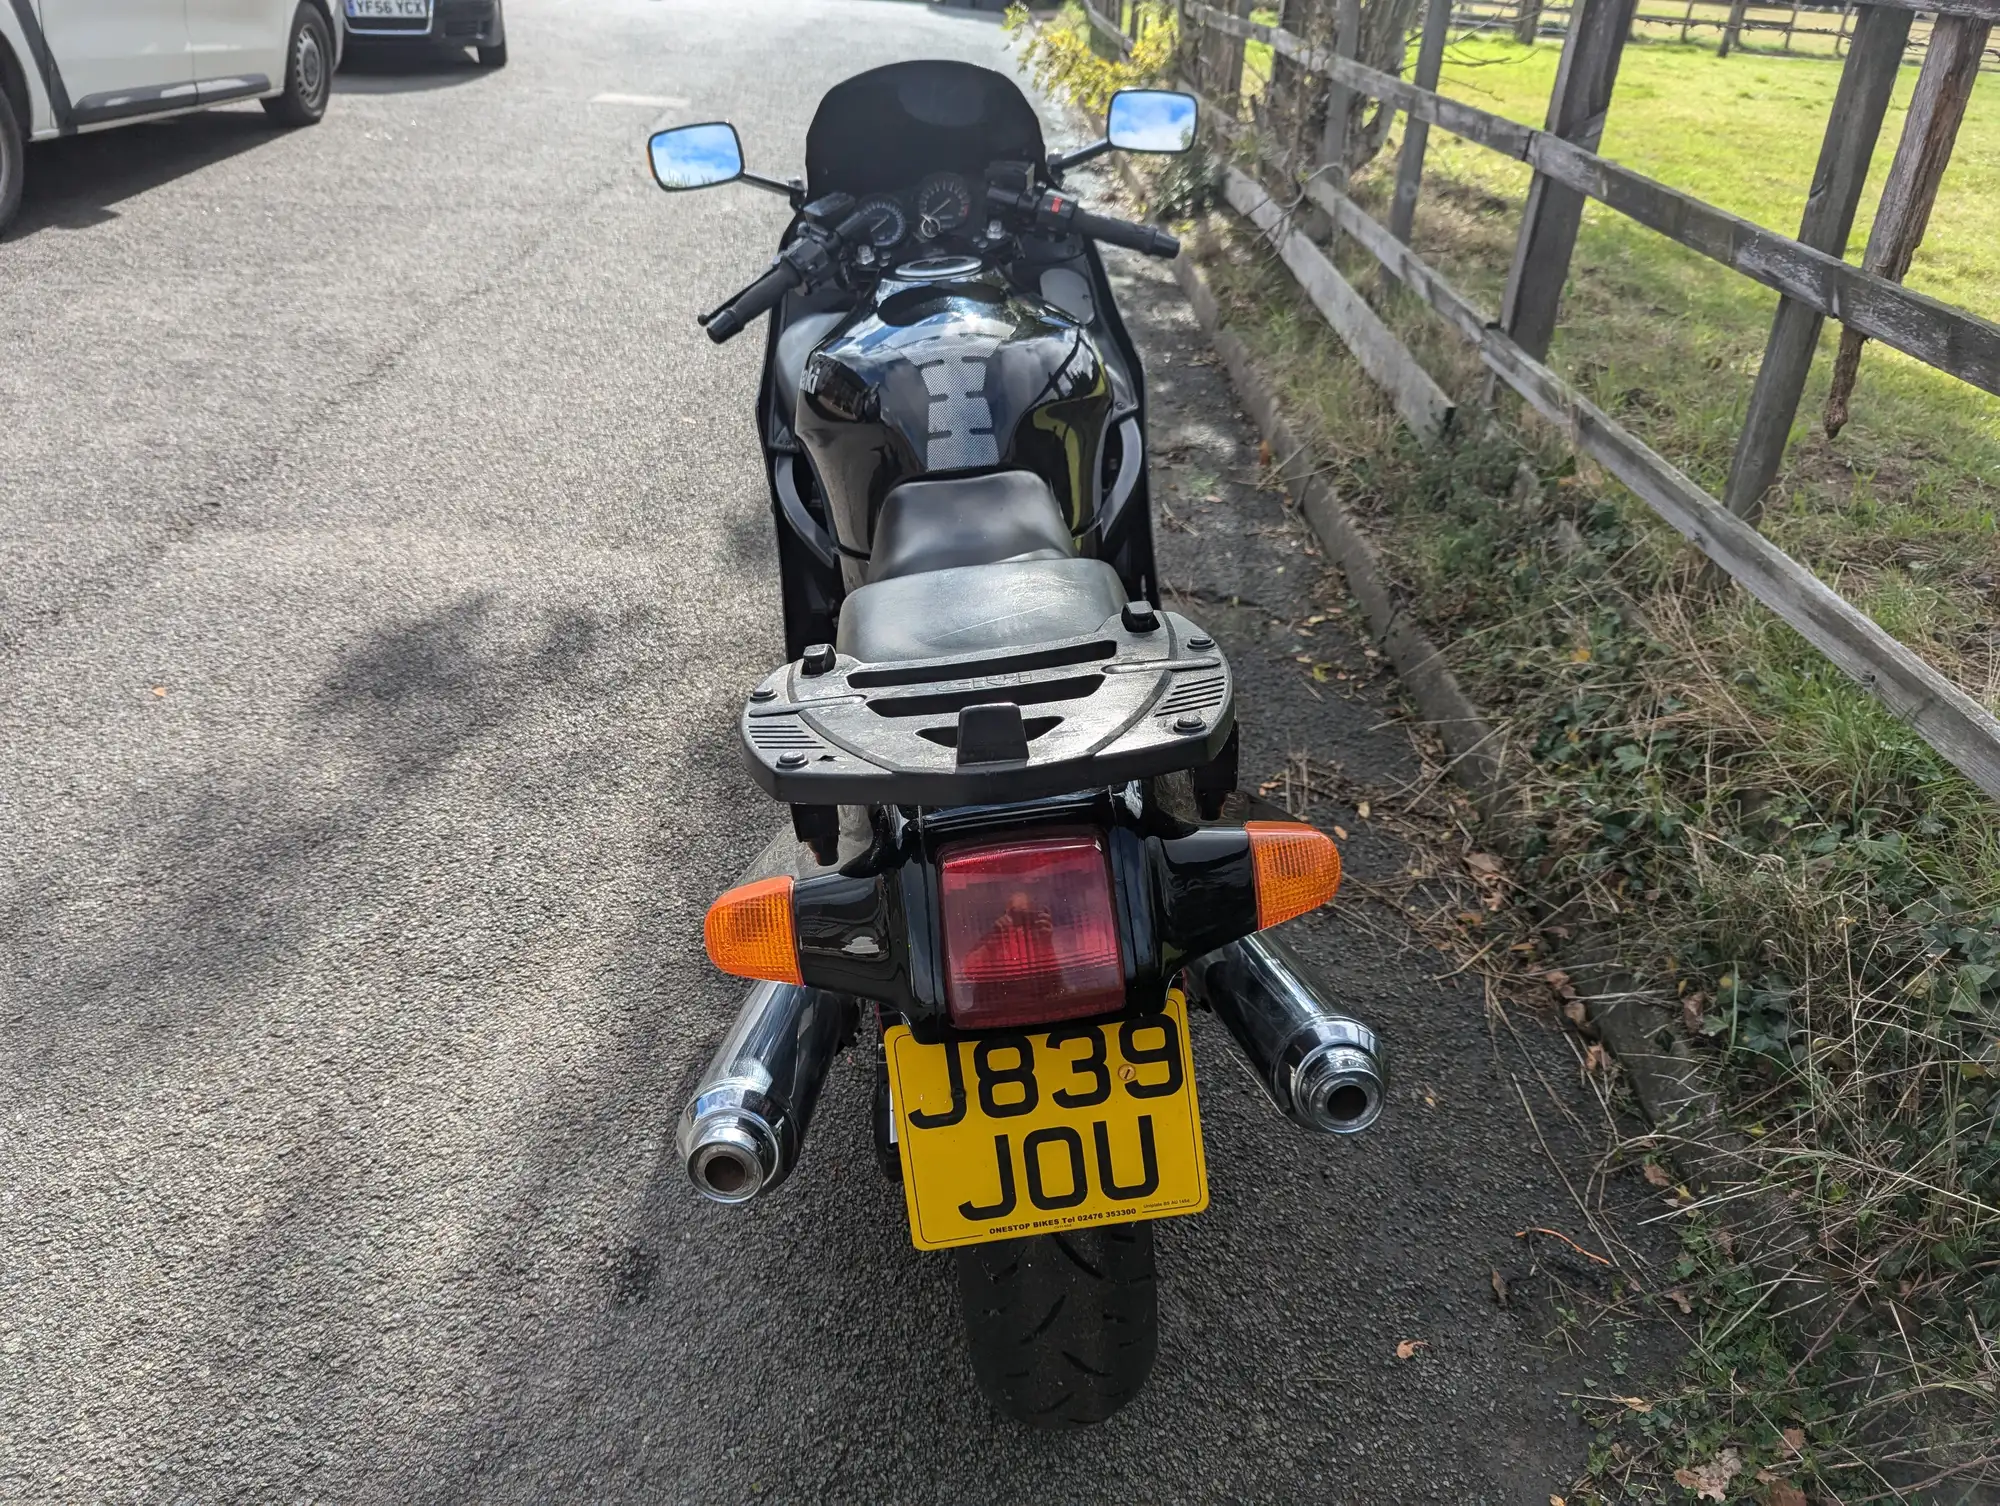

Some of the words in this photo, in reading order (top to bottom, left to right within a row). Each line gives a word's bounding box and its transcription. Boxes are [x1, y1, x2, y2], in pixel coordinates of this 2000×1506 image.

[357, 0, 393, 13] YF56
[396, 0, 423, 14] YCX
[908, 1013, 1184, 1130] J839
[958, 1114, 1160, 1221] JOU
[989, 1223, 1031, 1235] ONESTOP
[1033, 1219, 1060, 1229] BIKES
[1062, 1216, 1075, 1225] Tel
[1077, 1212, 1104, 1222] 02476
[1105, 1208, 1137, 1219] 353300
